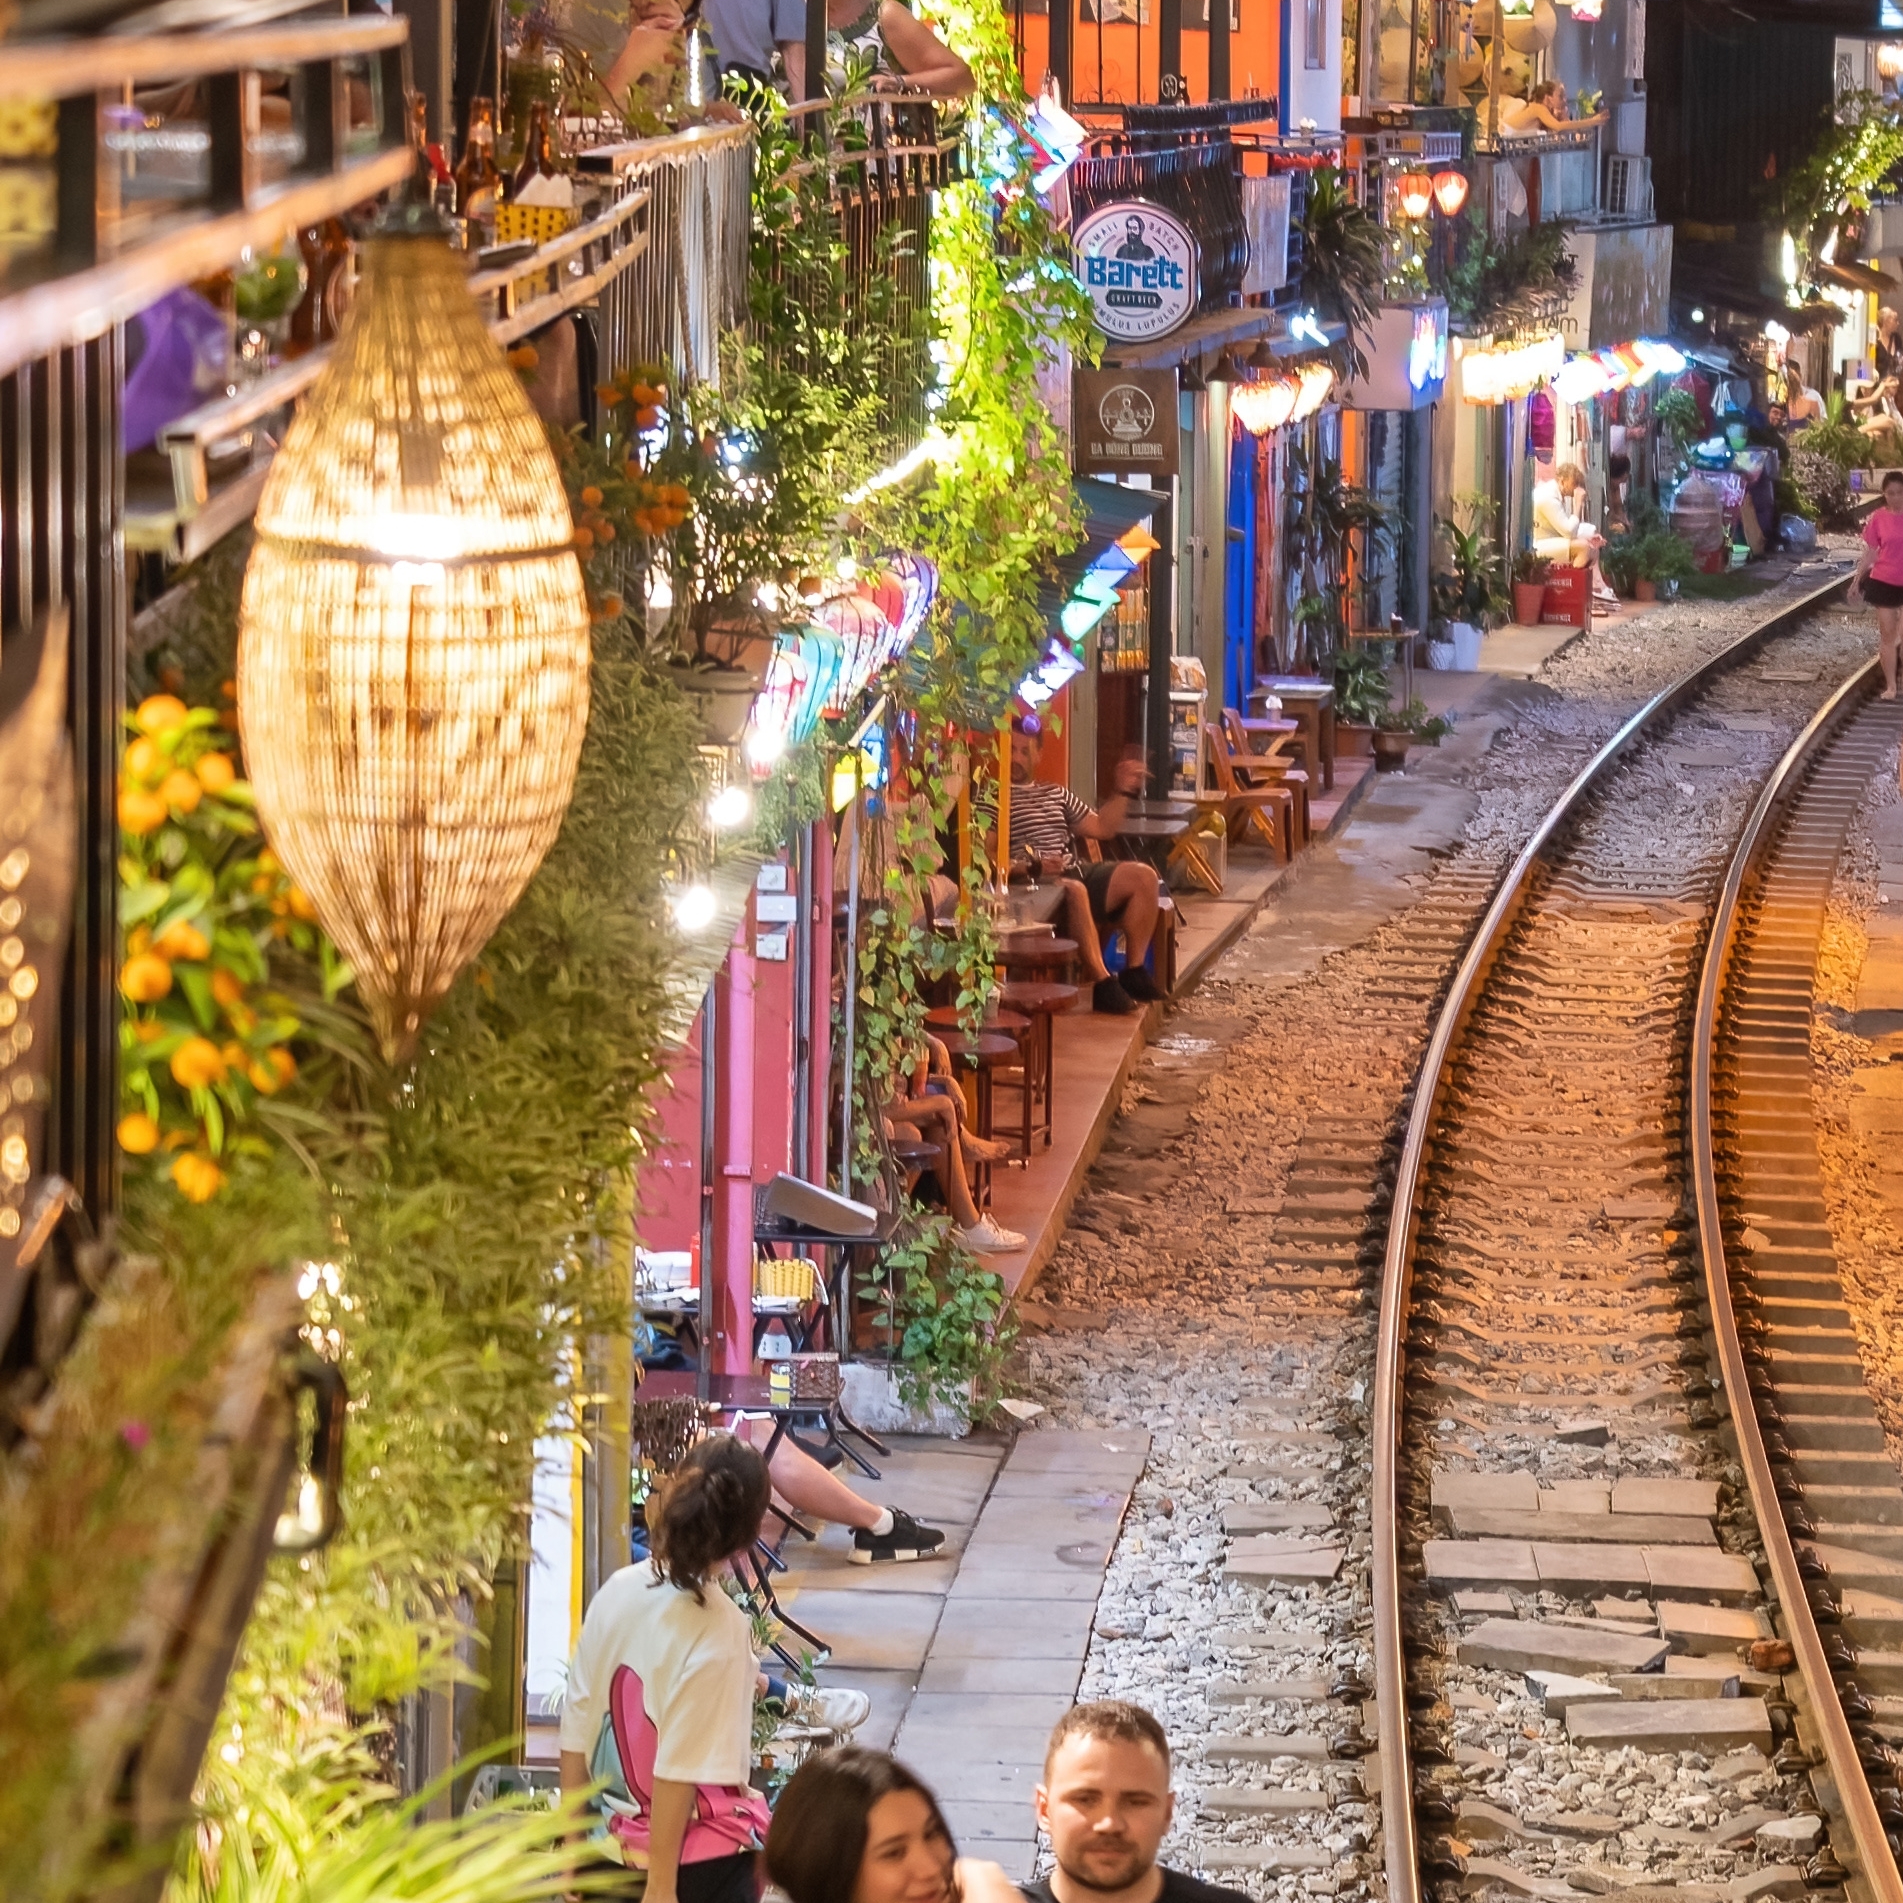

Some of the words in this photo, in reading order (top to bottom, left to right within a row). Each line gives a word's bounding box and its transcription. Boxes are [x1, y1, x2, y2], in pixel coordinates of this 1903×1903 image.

[1088, 221, 1118, 247] SMALL
[1149, 222, 1179, 250] BATCH
[1084, 255, 1183, 290] Barett
[1096, 305, 1131, 330] MULUS
